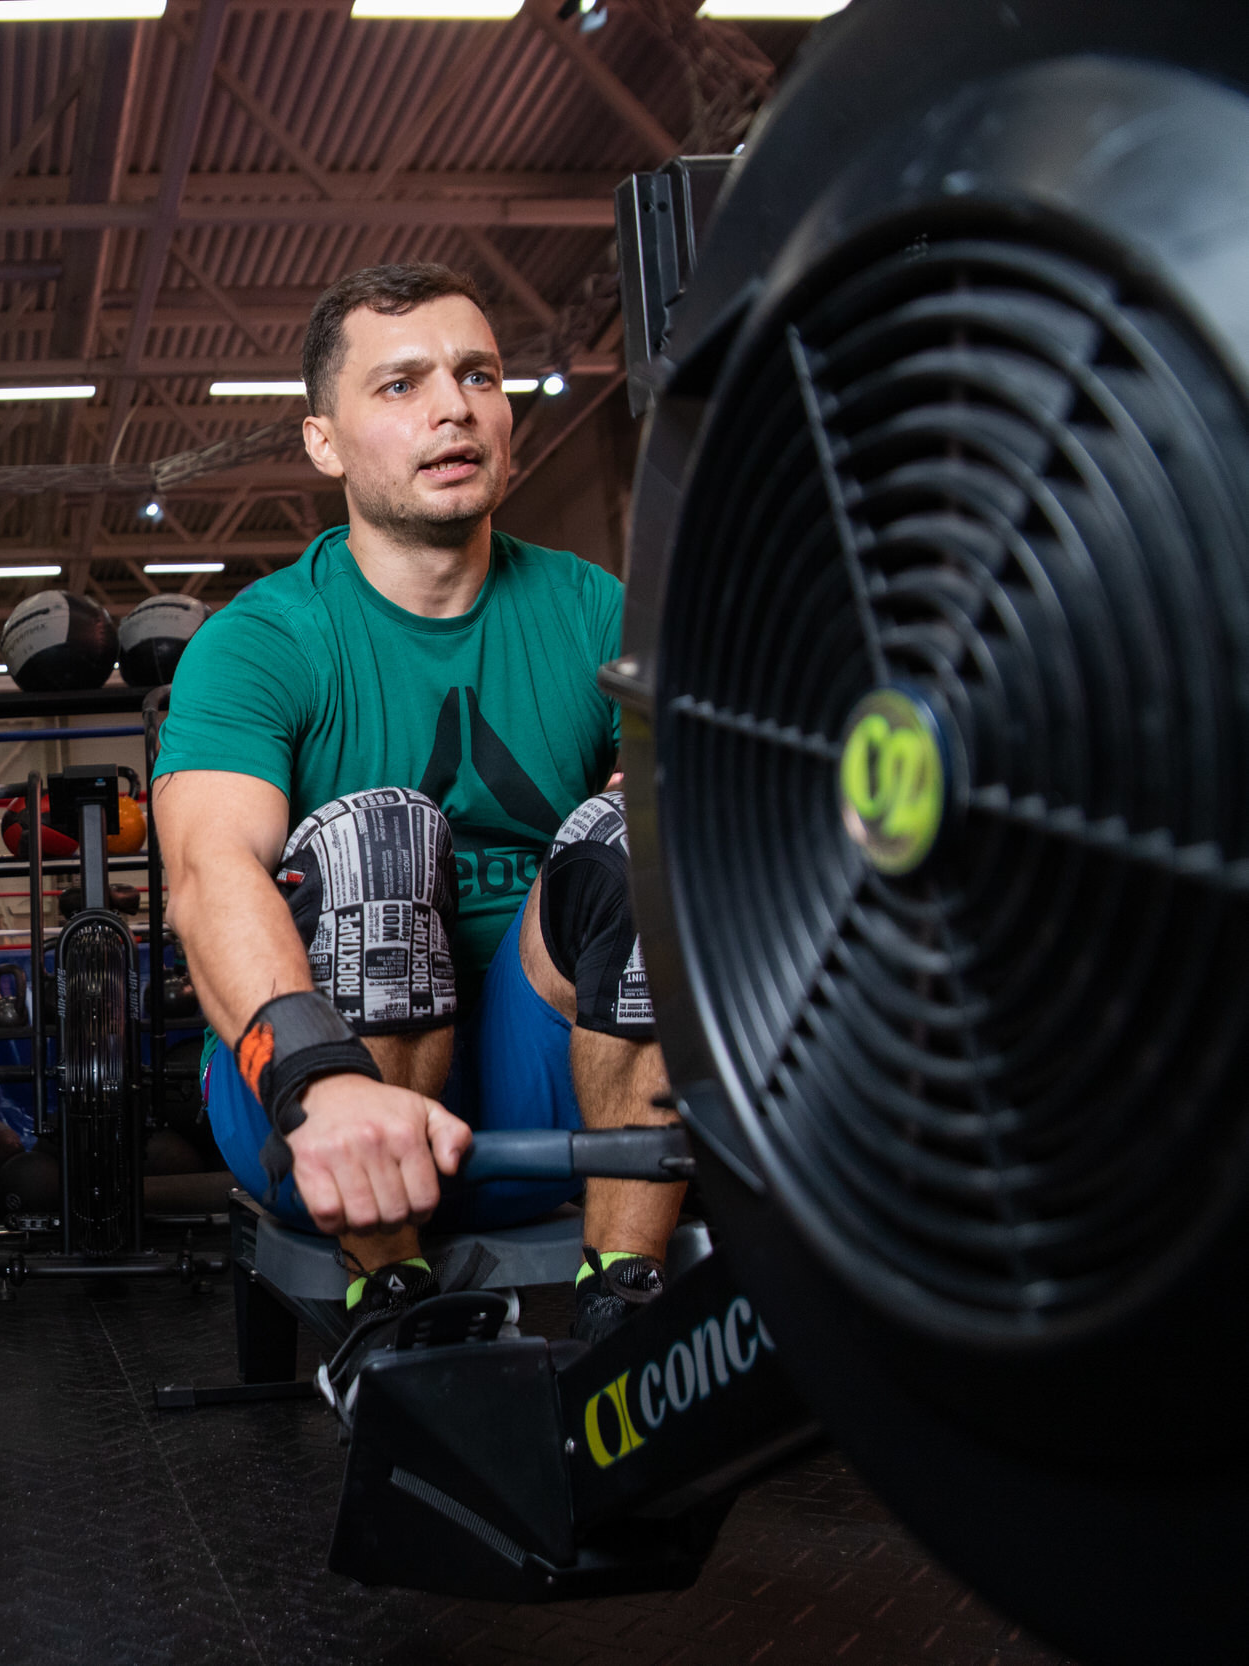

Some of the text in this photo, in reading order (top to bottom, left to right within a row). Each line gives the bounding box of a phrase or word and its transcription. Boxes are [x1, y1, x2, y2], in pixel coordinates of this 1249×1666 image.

[382, 903, 399, 942] WOD
[399, 903, 411, 942] Forever
[412, 910, 429, 992] ROCKTAPE
[337, 912, 361, 996] ROCKTAPE
